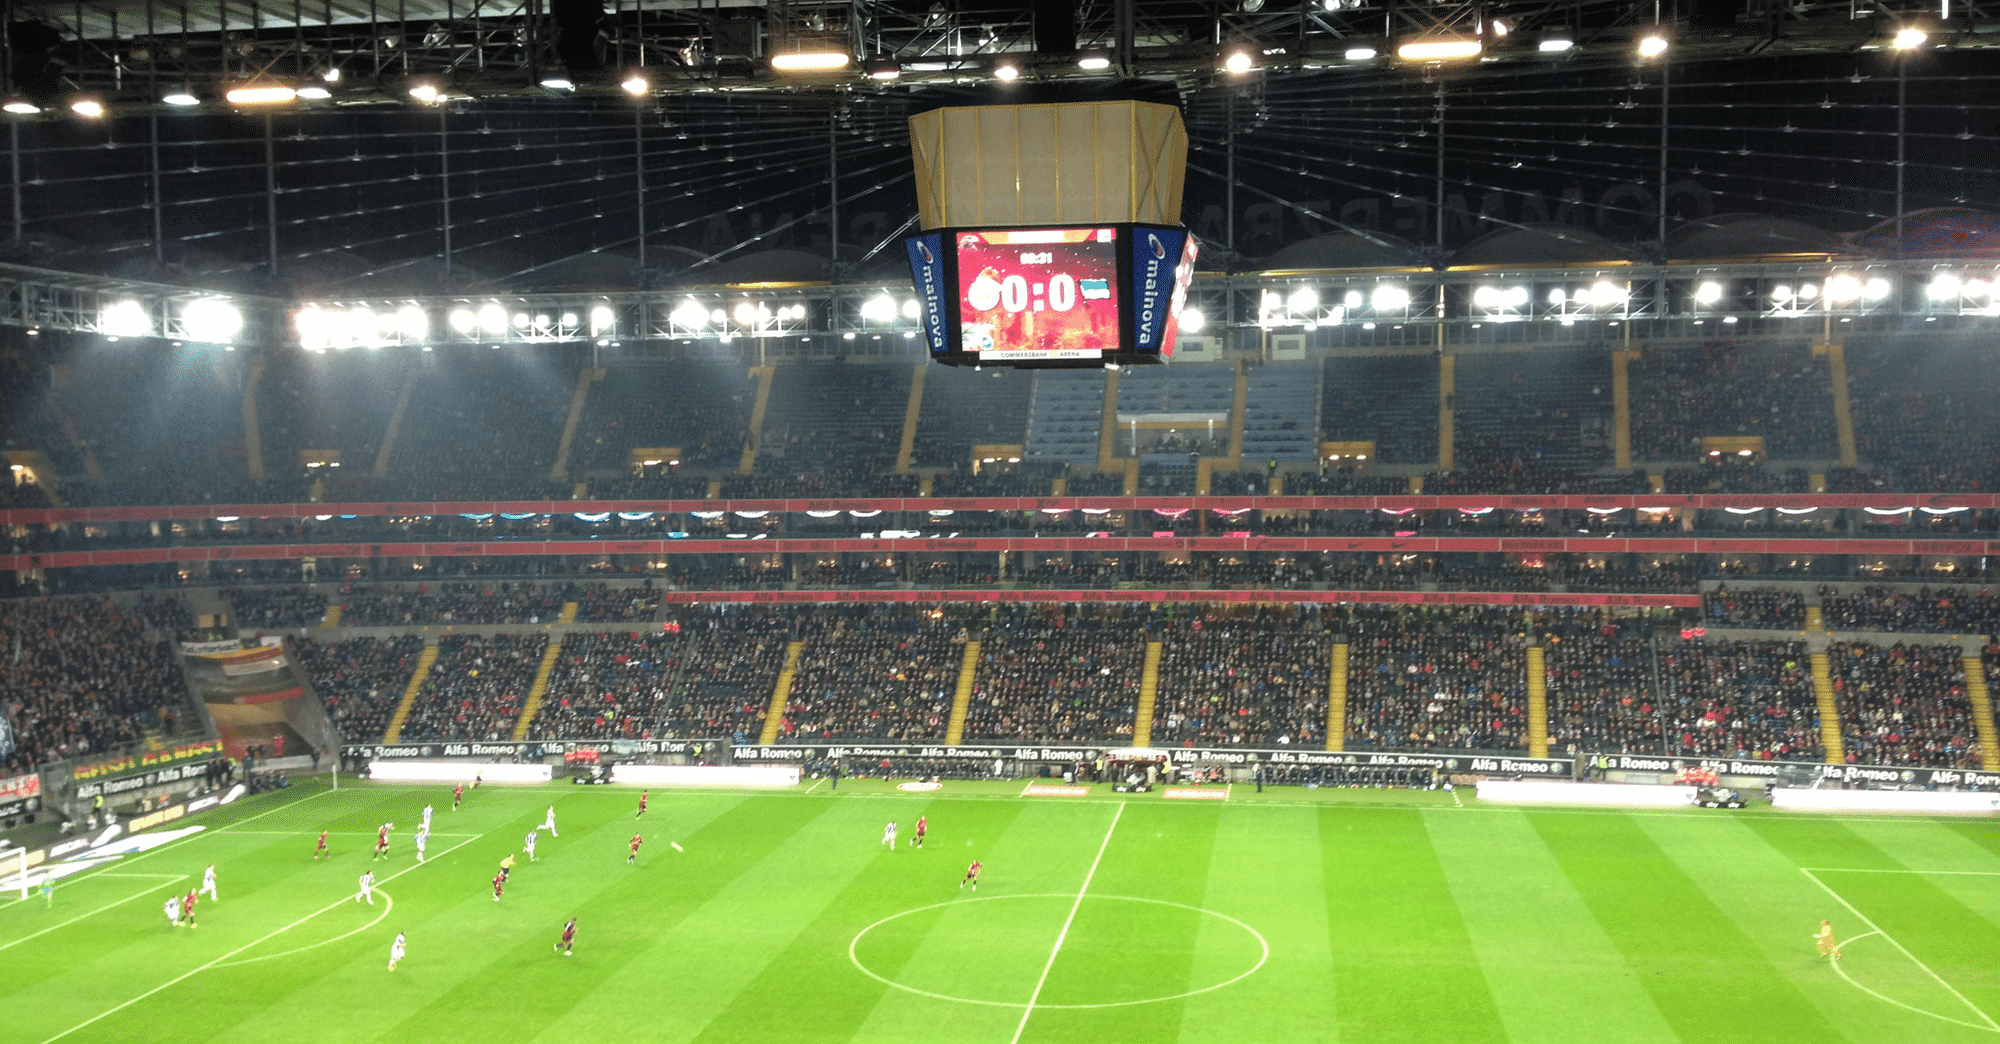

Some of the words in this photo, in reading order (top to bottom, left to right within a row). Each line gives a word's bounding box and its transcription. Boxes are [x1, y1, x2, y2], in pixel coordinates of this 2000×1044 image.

[1001, 273, 1076, 313] 0:0
[922, 264, 943, 348] mainova
[1138, 259, 1159, 344] mainova
[444, 744, 469, 756] Alfa
[472, 744, 515, 755] Romeo
[661, 742, 686, 753] Rom
[733, 748, 758, 759] Alfa
[760, 748, 803, 759] Romeo
[920, 748, 944, 757] Alfa
[947, 748, 989, 758] Romeo
[1014, 749, 1038, 760] Alfa
[1041, 749, 1084, 760] Romeo
[1173, 751, 1198, 762] Alfa
[1201, 751, 1244, 763] Romeo
[1271, 753, 1295, 763] Alfa
[1298, 753, 1343, 764] Romeo
[1369, 756, 1395, 765] Alfa
[1398, 756, 1444, 769] Romeo
[1470, 758, 1498, 771] Alfa
[1589, 755, 1617, 768] Aa
[1620, 757, 1670, 770] Romeo
[157, 767, 181, 783] Alfa
[1930, 770, 1961, 783] Alfa
[77, 784, 101, 799] Alfa
[103, 777, 144, 794] Romeo
